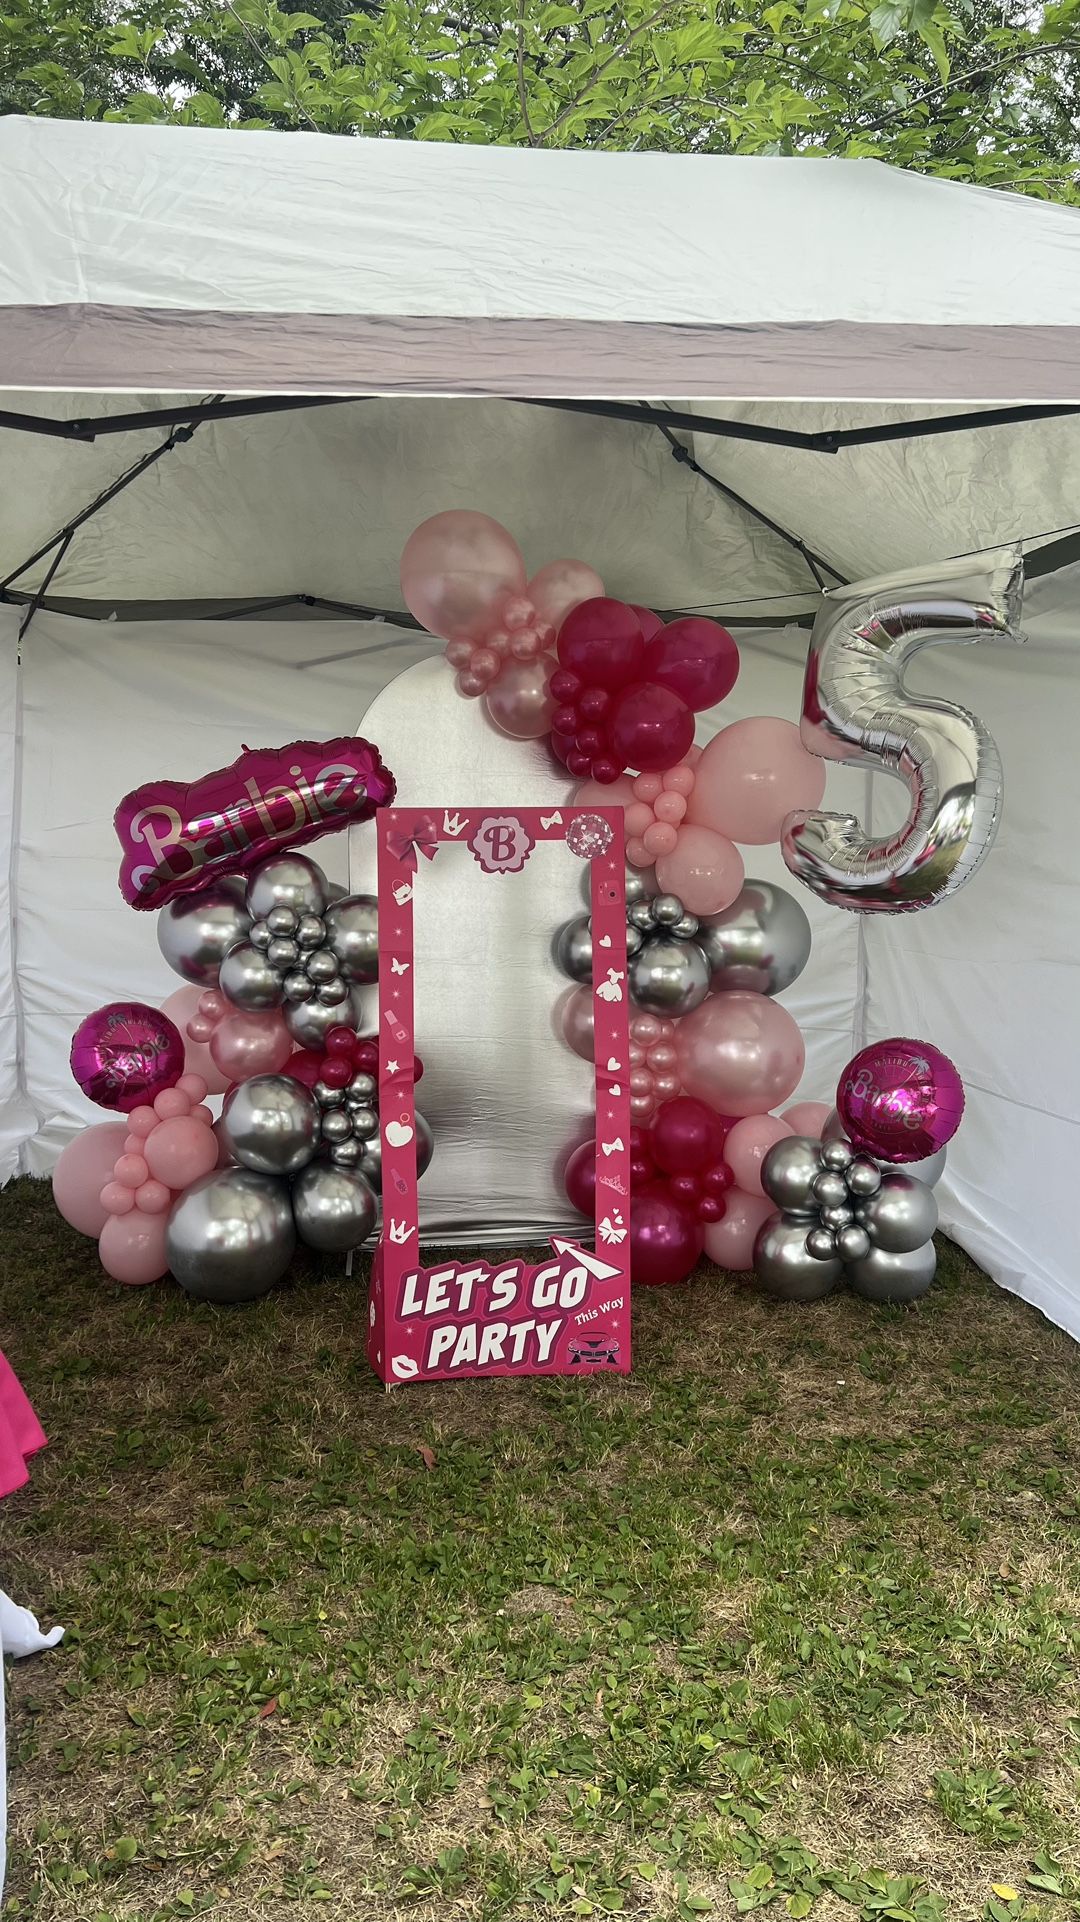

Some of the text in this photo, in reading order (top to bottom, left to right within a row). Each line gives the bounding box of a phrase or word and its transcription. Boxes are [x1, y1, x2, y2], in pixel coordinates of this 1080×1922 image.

[780, 547, 1027, 917] 5
[130, 763, 368, 895] Barbie
[483, 825, 516, 862] B
[401, 1265, 588, 1317] LET'S GO
[574, 1296, 625, 1326] This Way
[427, 1318, 563, 1370] PARTY
